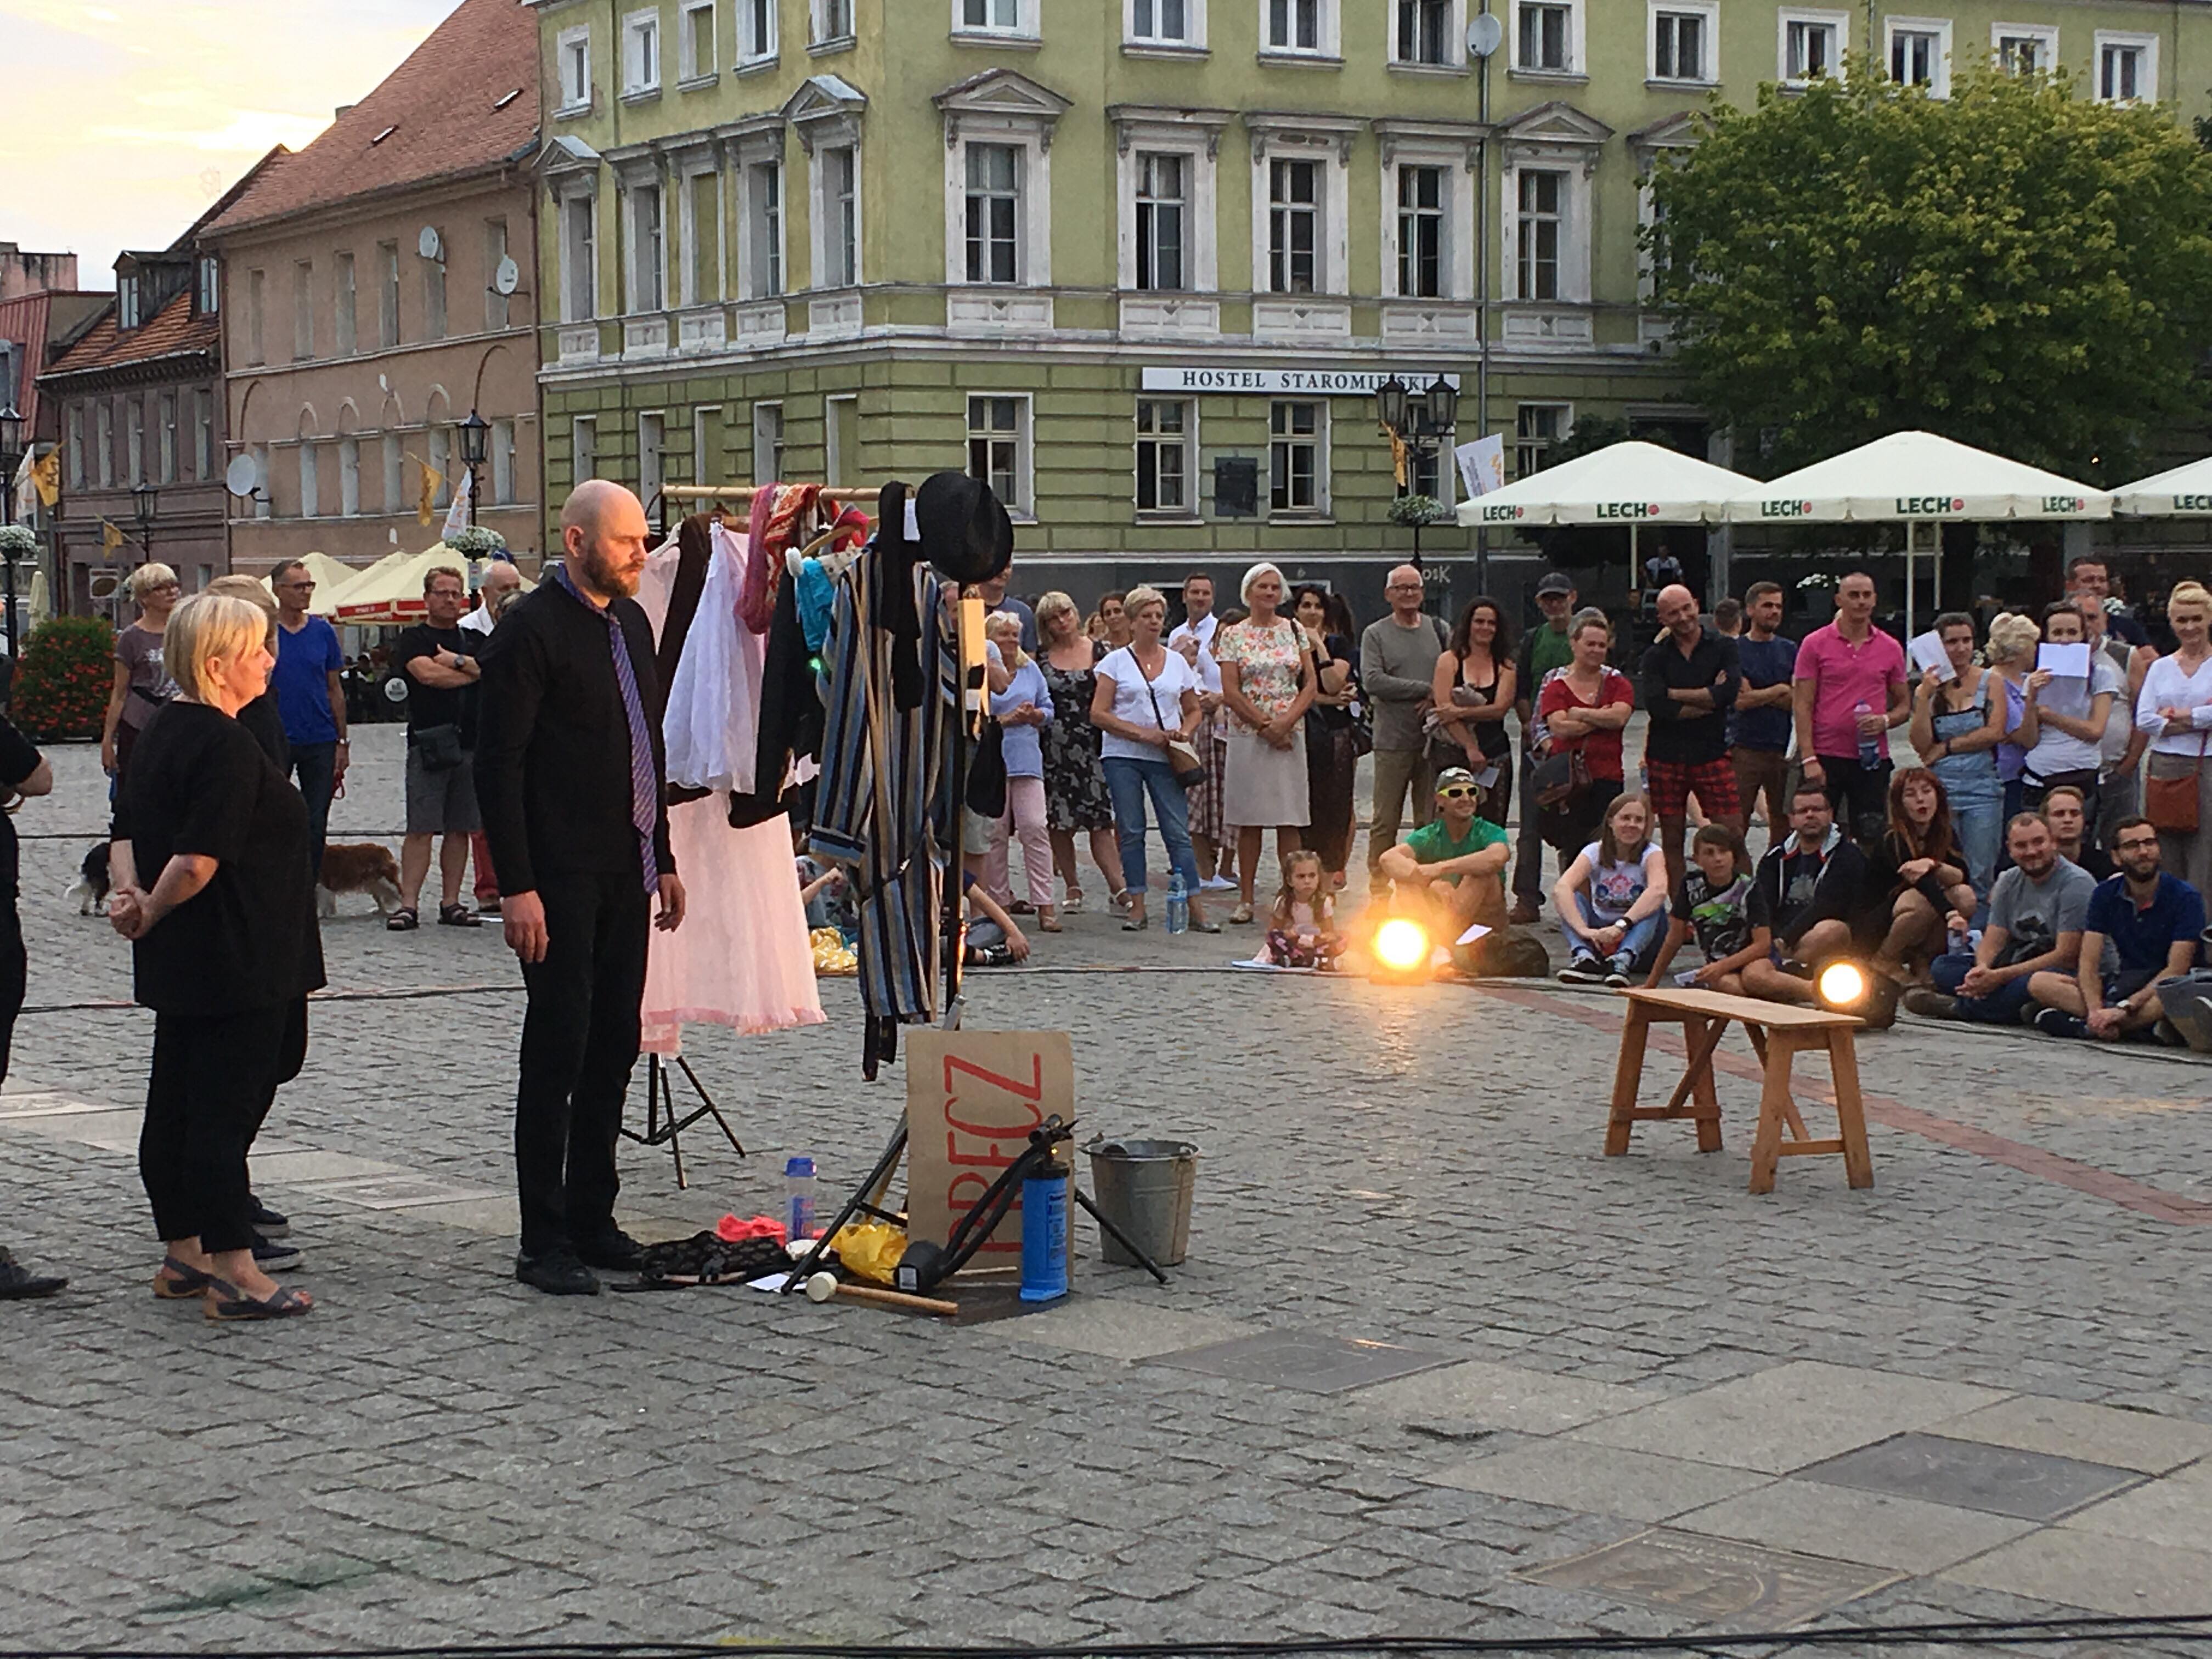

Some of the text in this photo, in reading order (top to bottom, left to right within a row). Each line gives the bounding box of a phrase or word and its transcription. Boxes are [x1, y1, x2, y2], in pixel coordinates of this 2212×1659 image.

[1182, 371, 1429, 391] HOSTEL STAROMIESKI
[1596, 503, 1647, 518] LECH
[1761, 500, 1803, 516] LECH
[1896, 497, 1951, 514] LECH
[2041, 496, 2076, 512] LECH
[1483, 505, 1516, 521] LECH
